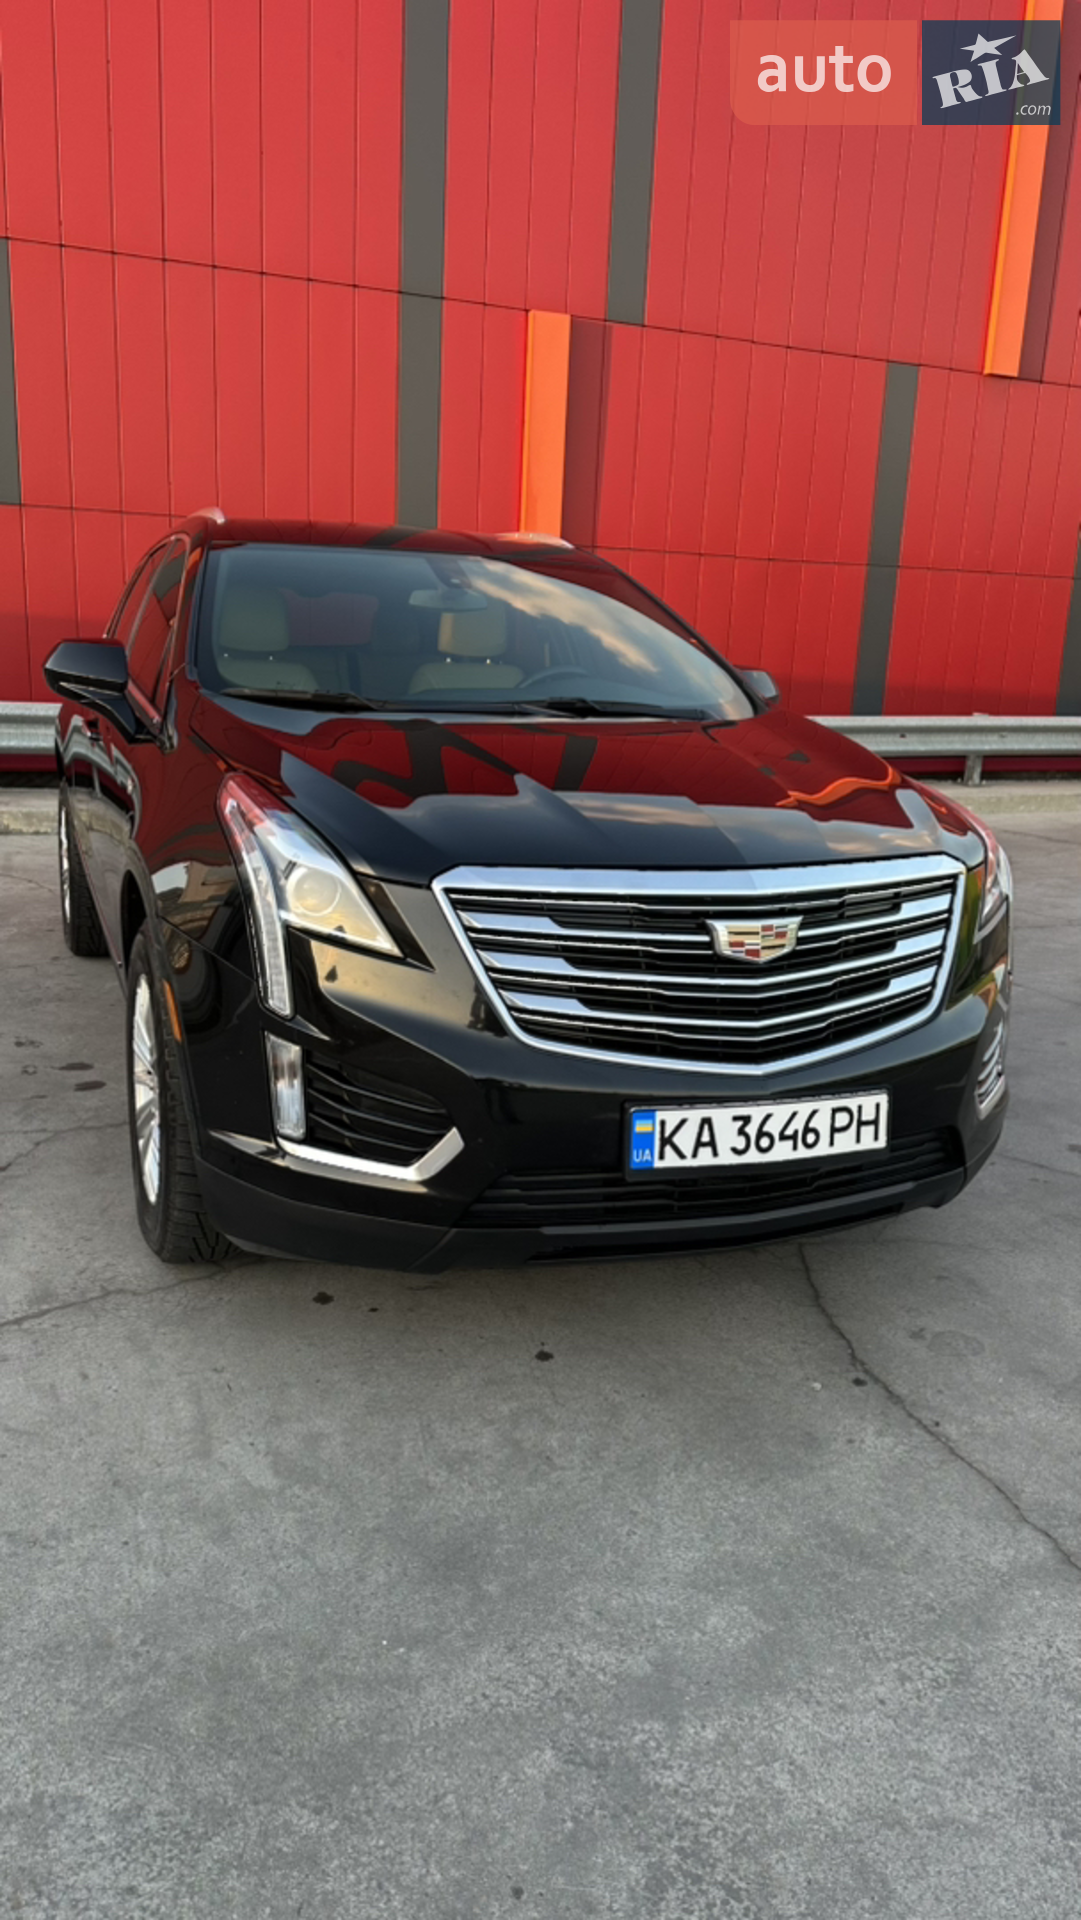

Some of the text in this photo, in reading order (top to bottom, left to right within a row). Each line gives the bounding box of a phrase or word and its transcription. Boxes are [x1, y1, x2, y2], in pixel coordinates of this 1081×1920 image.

[658, 1102, 881, 1161] KA 3646 PH
[633, 1149, 653, 1163] UA
